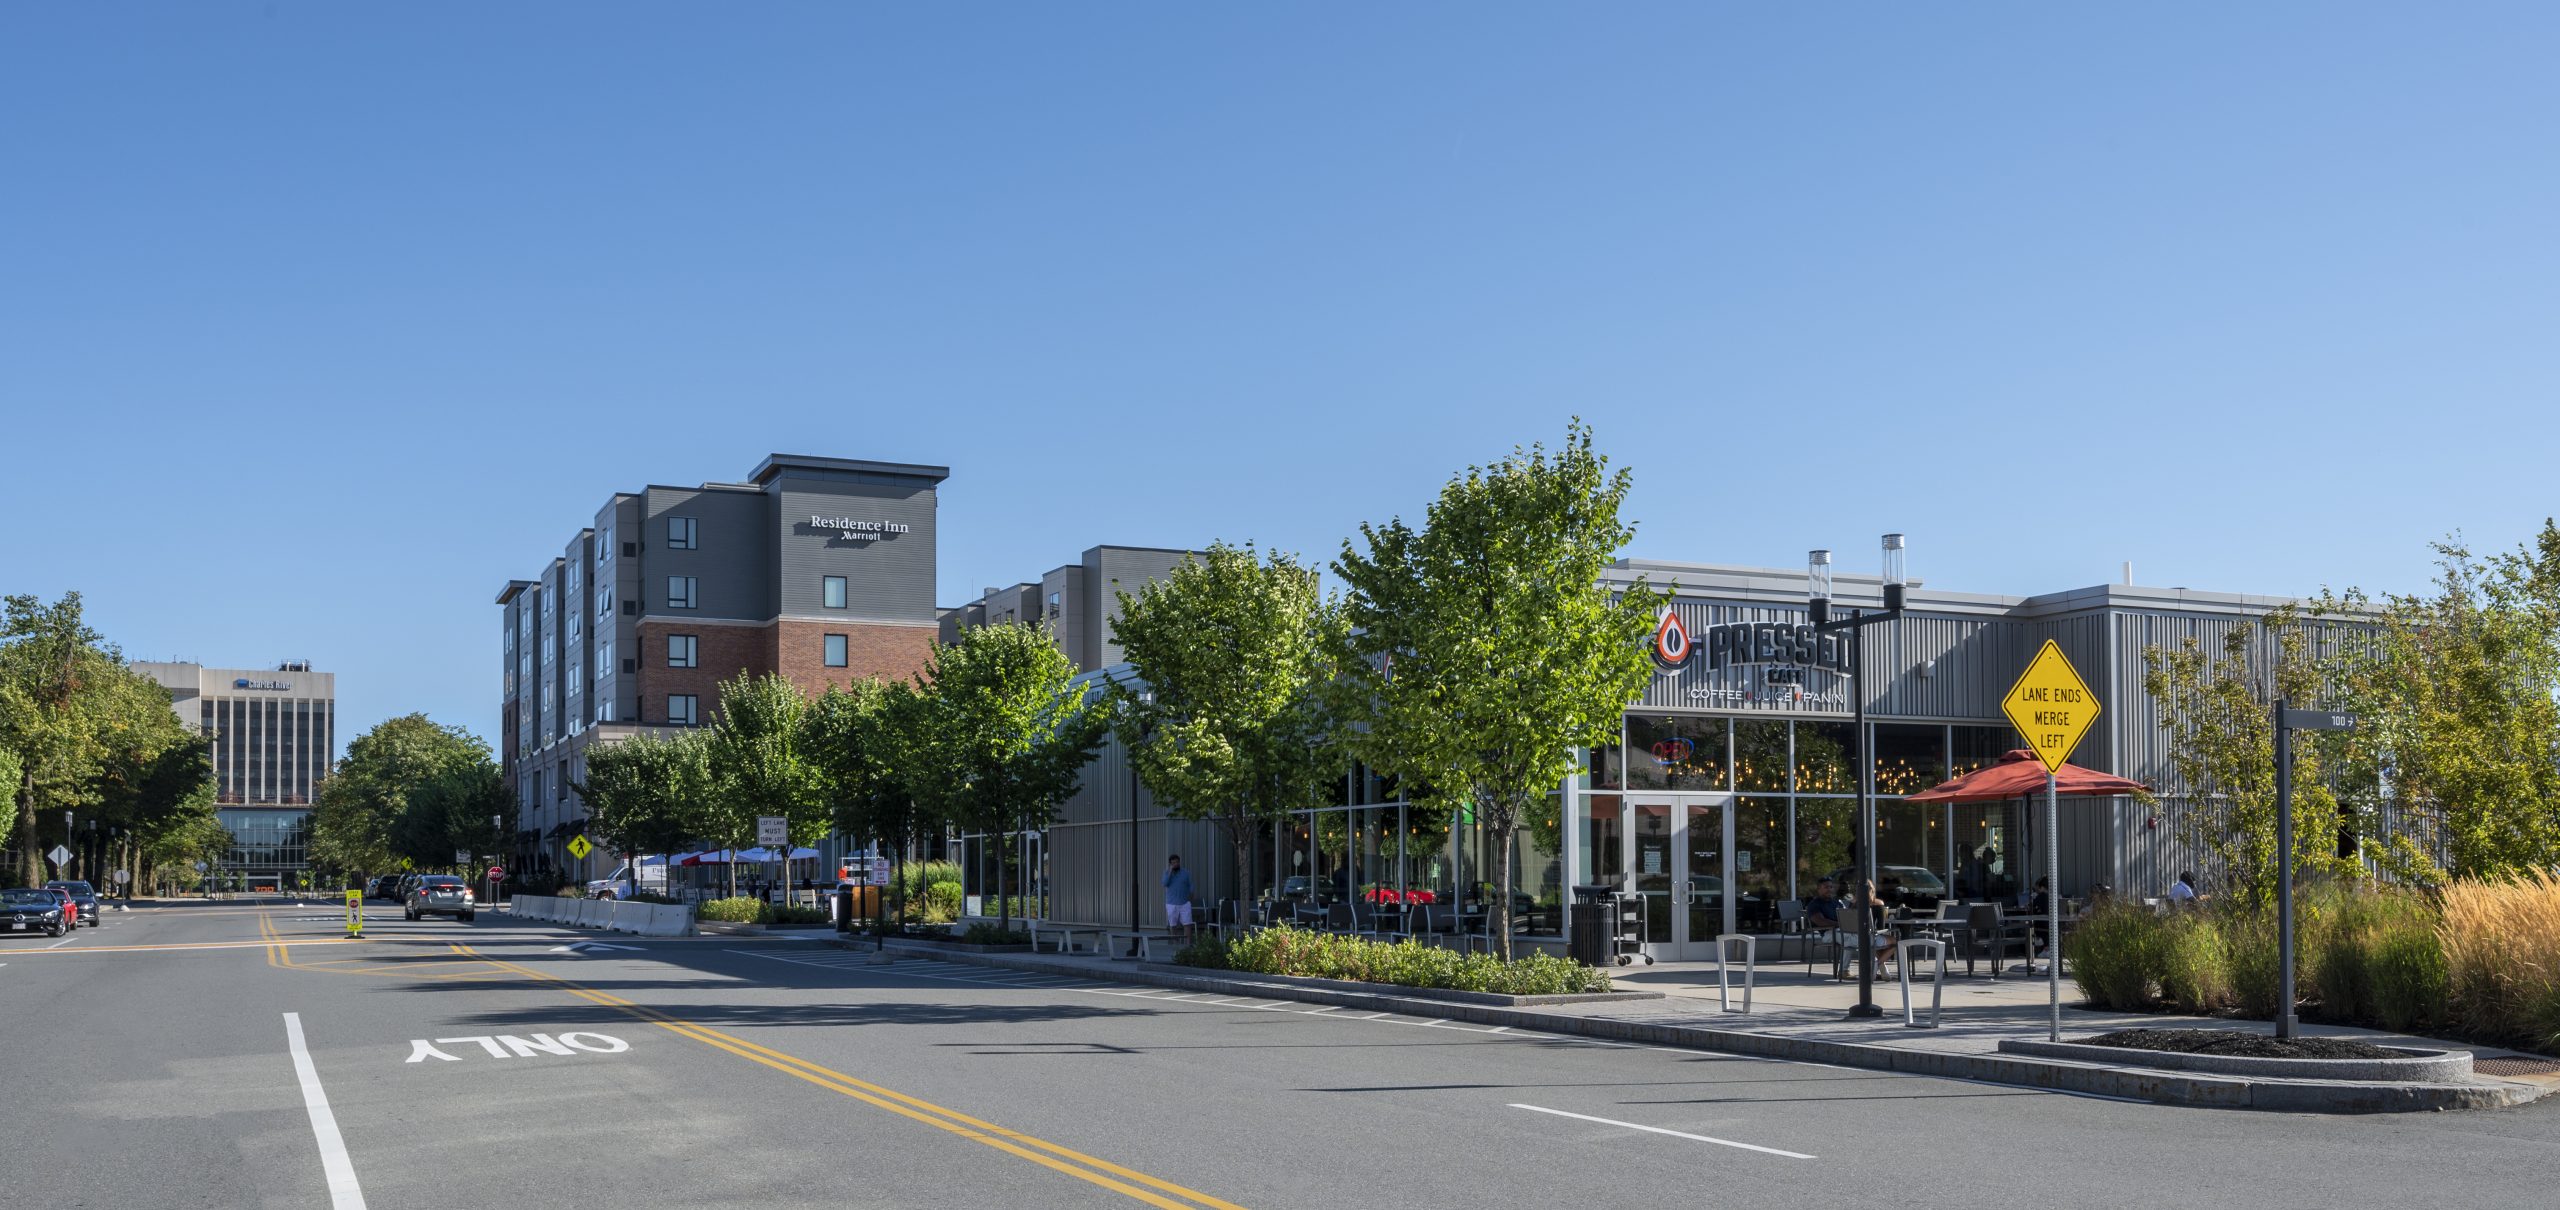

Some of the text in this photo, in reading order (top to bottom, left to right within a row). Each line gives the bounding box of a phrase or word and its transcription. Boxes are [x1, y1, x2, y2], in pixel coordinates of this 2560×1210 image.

[811, 516, 909, 533] Residence Inn
[1705, 622, 1855, 677] PRESSED
[249, 680, 274, 689] Charles
[1690, 689, 1744, 700] COFFEE
[1754, 690, 1793, 702] JUICE
[2023, 687, 2081, 703] LANE ENDS
[2035, 711, 2069, 725] MERGE
[2332, 716, 2346, 726] 100
[2041, 734, 2064, 748] LEFT
[1652, 742, 1690, 760] OPEN
[405, 1032, 629, 1063] ONLY
